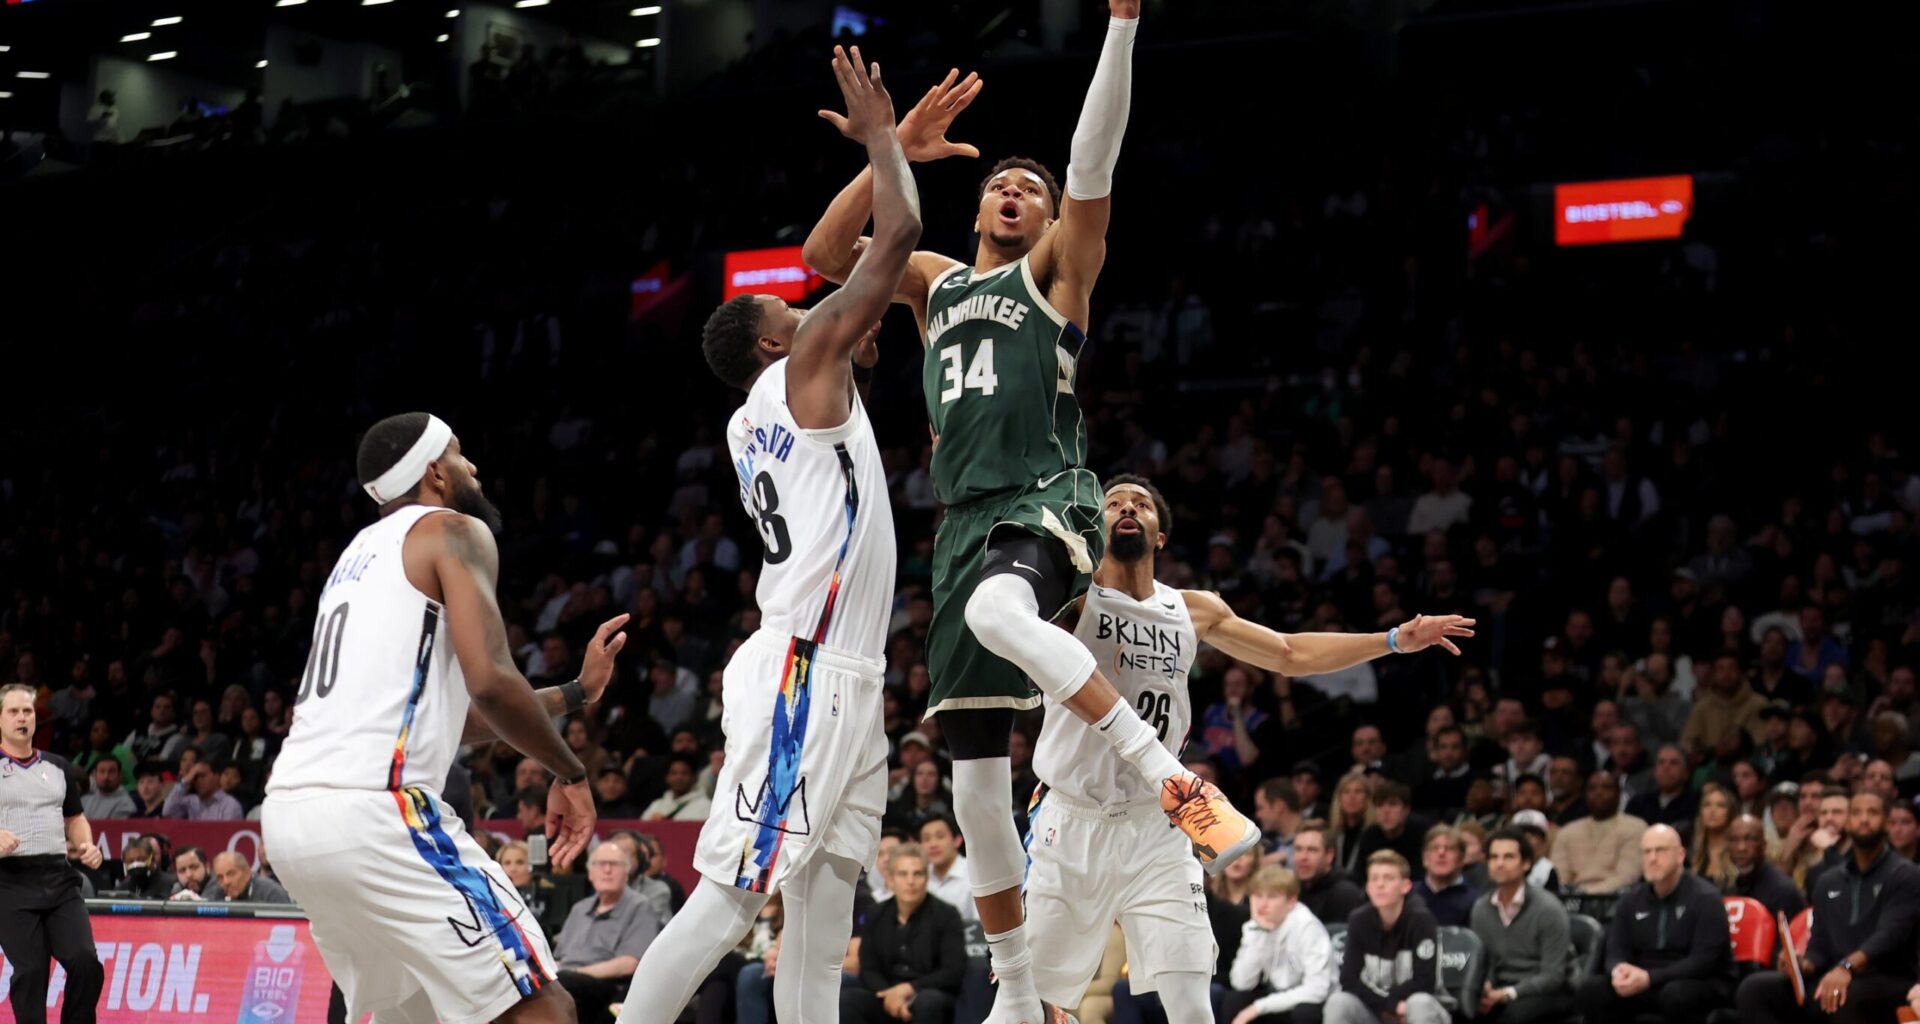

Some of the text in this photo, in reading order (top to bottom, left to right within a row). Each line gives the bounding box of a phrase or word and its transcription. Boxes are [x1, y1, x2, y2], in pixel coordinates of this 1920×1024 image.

[927, 294, 1030, 350] MILWAUKEE
[940, 338, 998, 404] 34
[1096, 613, 1181, 656] BKLYN
[1137, 690, 1171, 742] 26
[253, 990, 288, 1001] STEEL
[254, 967, 295, 988] BIO
